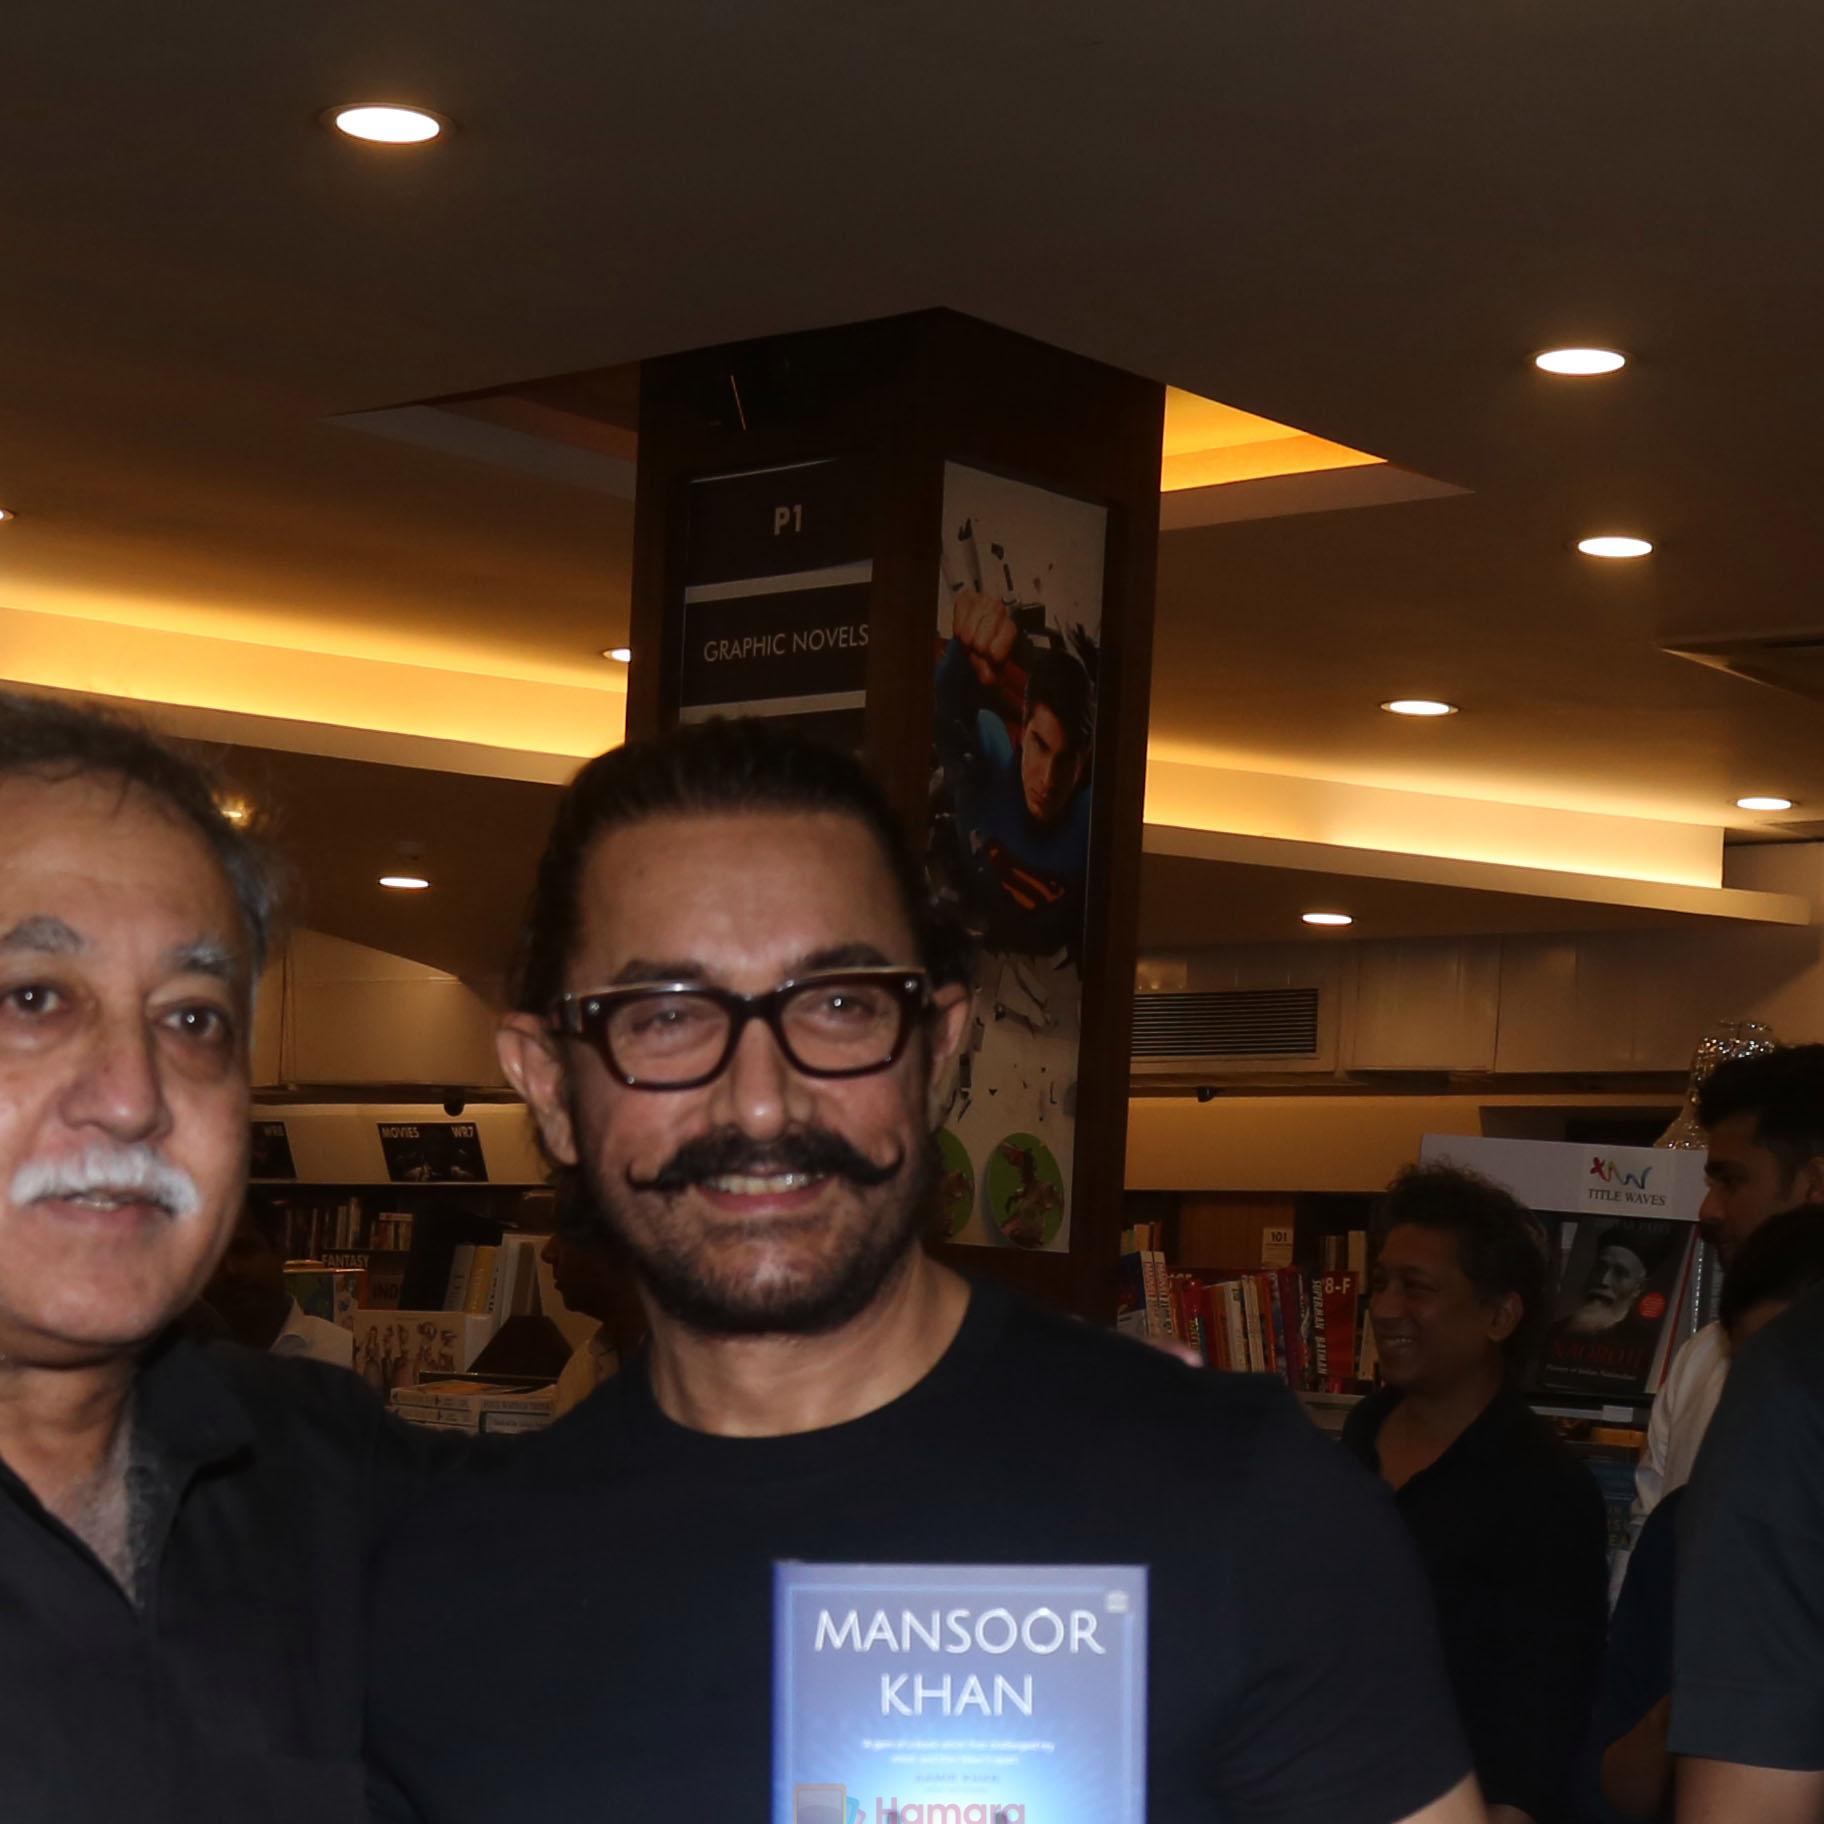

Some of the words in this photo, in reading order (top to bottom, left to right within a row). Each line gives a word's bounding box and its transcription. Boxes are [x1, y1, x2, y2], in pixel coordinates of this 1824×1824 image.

[774, 504, 803, 535] P1
[703, 633, 785, 662] GRAPHIC
[792, 624, 869, 653] NOVELS
[1588, 1188, 1620, 1203] TITLE
[1625, 1193, 1666, 1207] WAVES
[321, 1253, 369, 1269] FANTASY
[814, 1606, 1107, 1656] MANSOOR
[880, 1673, 1034, 1717] KHAN
